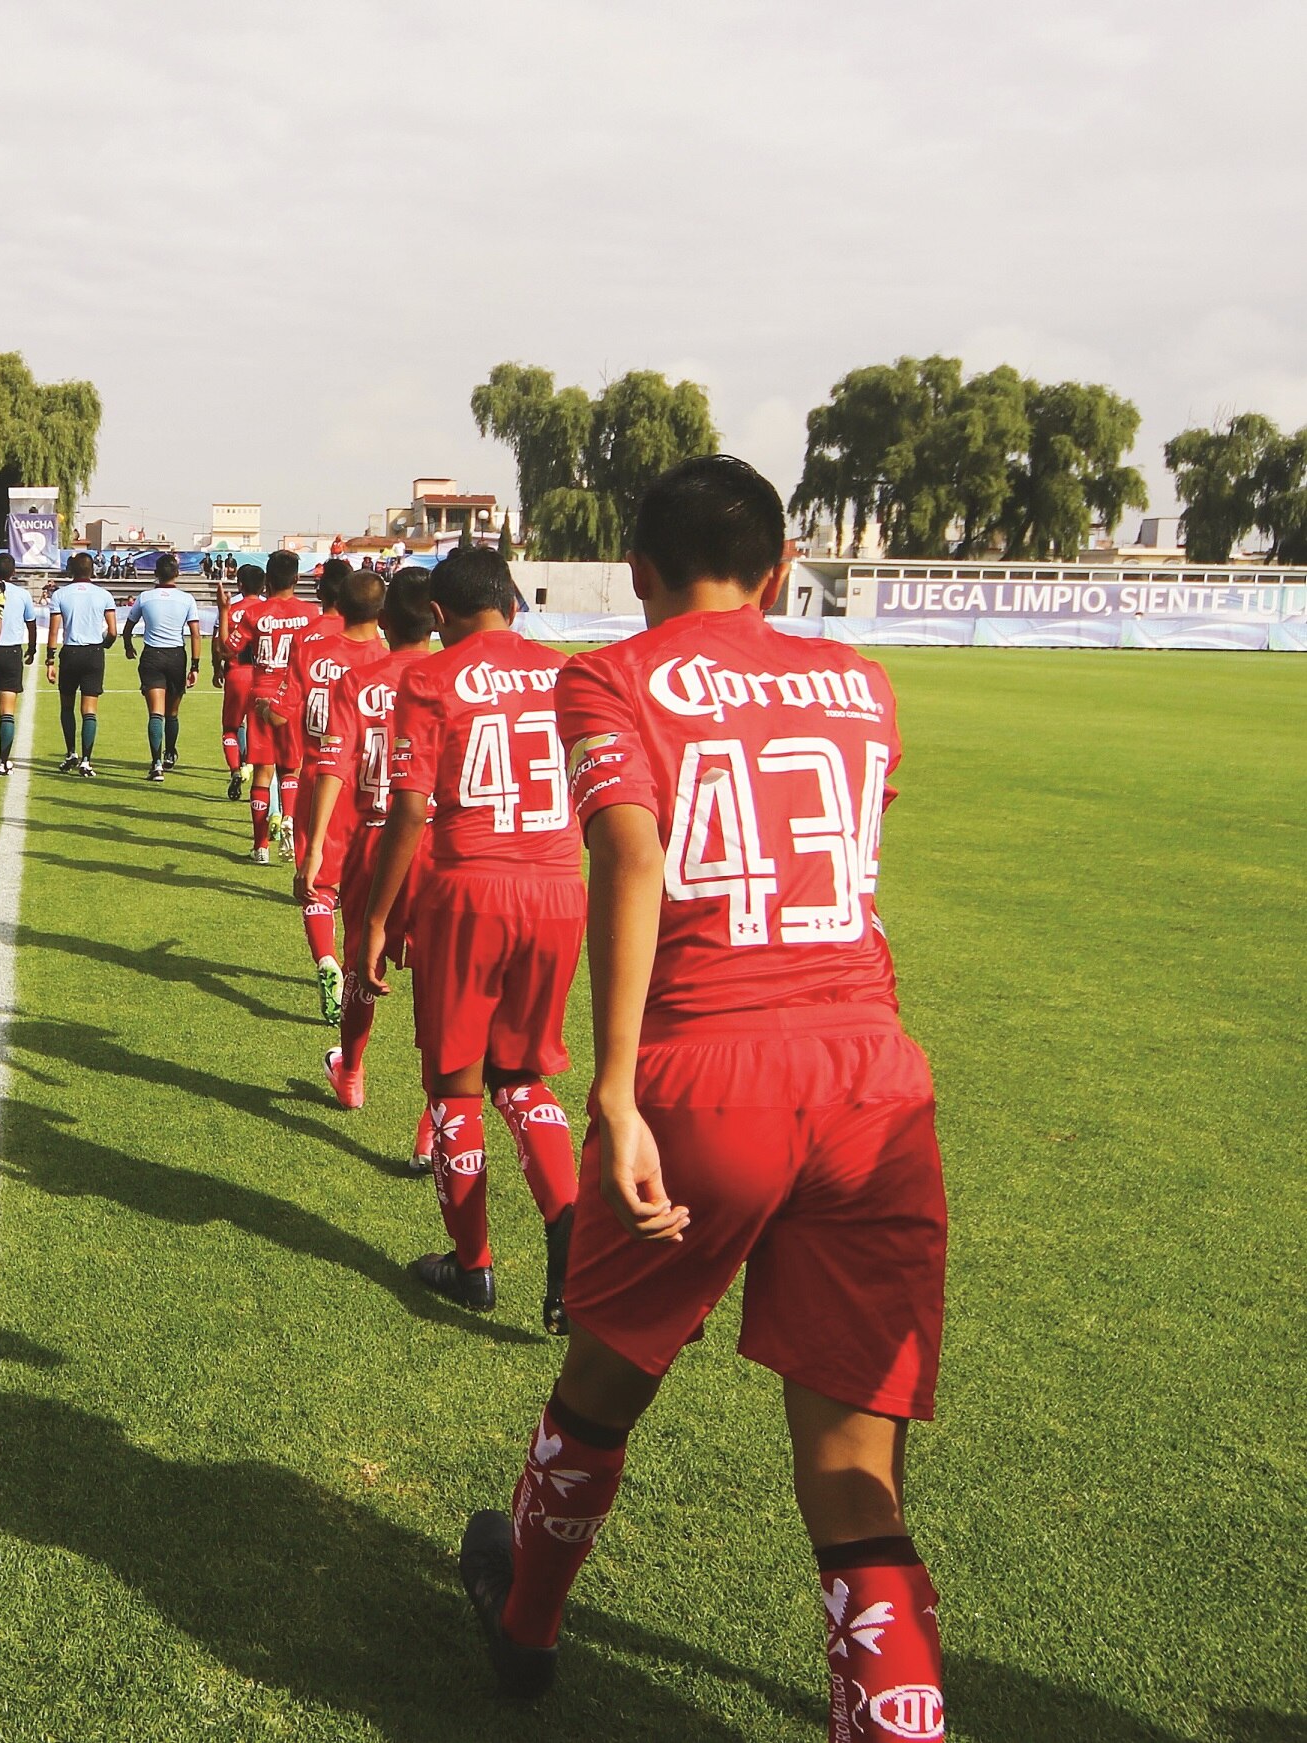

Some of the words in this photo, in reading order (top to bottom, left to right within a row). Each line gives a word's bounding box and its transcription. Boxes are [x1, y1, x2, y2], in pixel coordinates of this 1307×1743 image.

[13, 520, 54, 530] CANCHA
[22, 531, 46, 565] 2
[798, 586, 813, 617] 7
[883, 583, 987, 612] JUEGA
[994, 584, 1113, 617] LIMPIO,
[1118, 586, 1230, 614] SIENTE
[1237, 588, 1281, 616] TU
[648, 653, 879, 724] Corona
